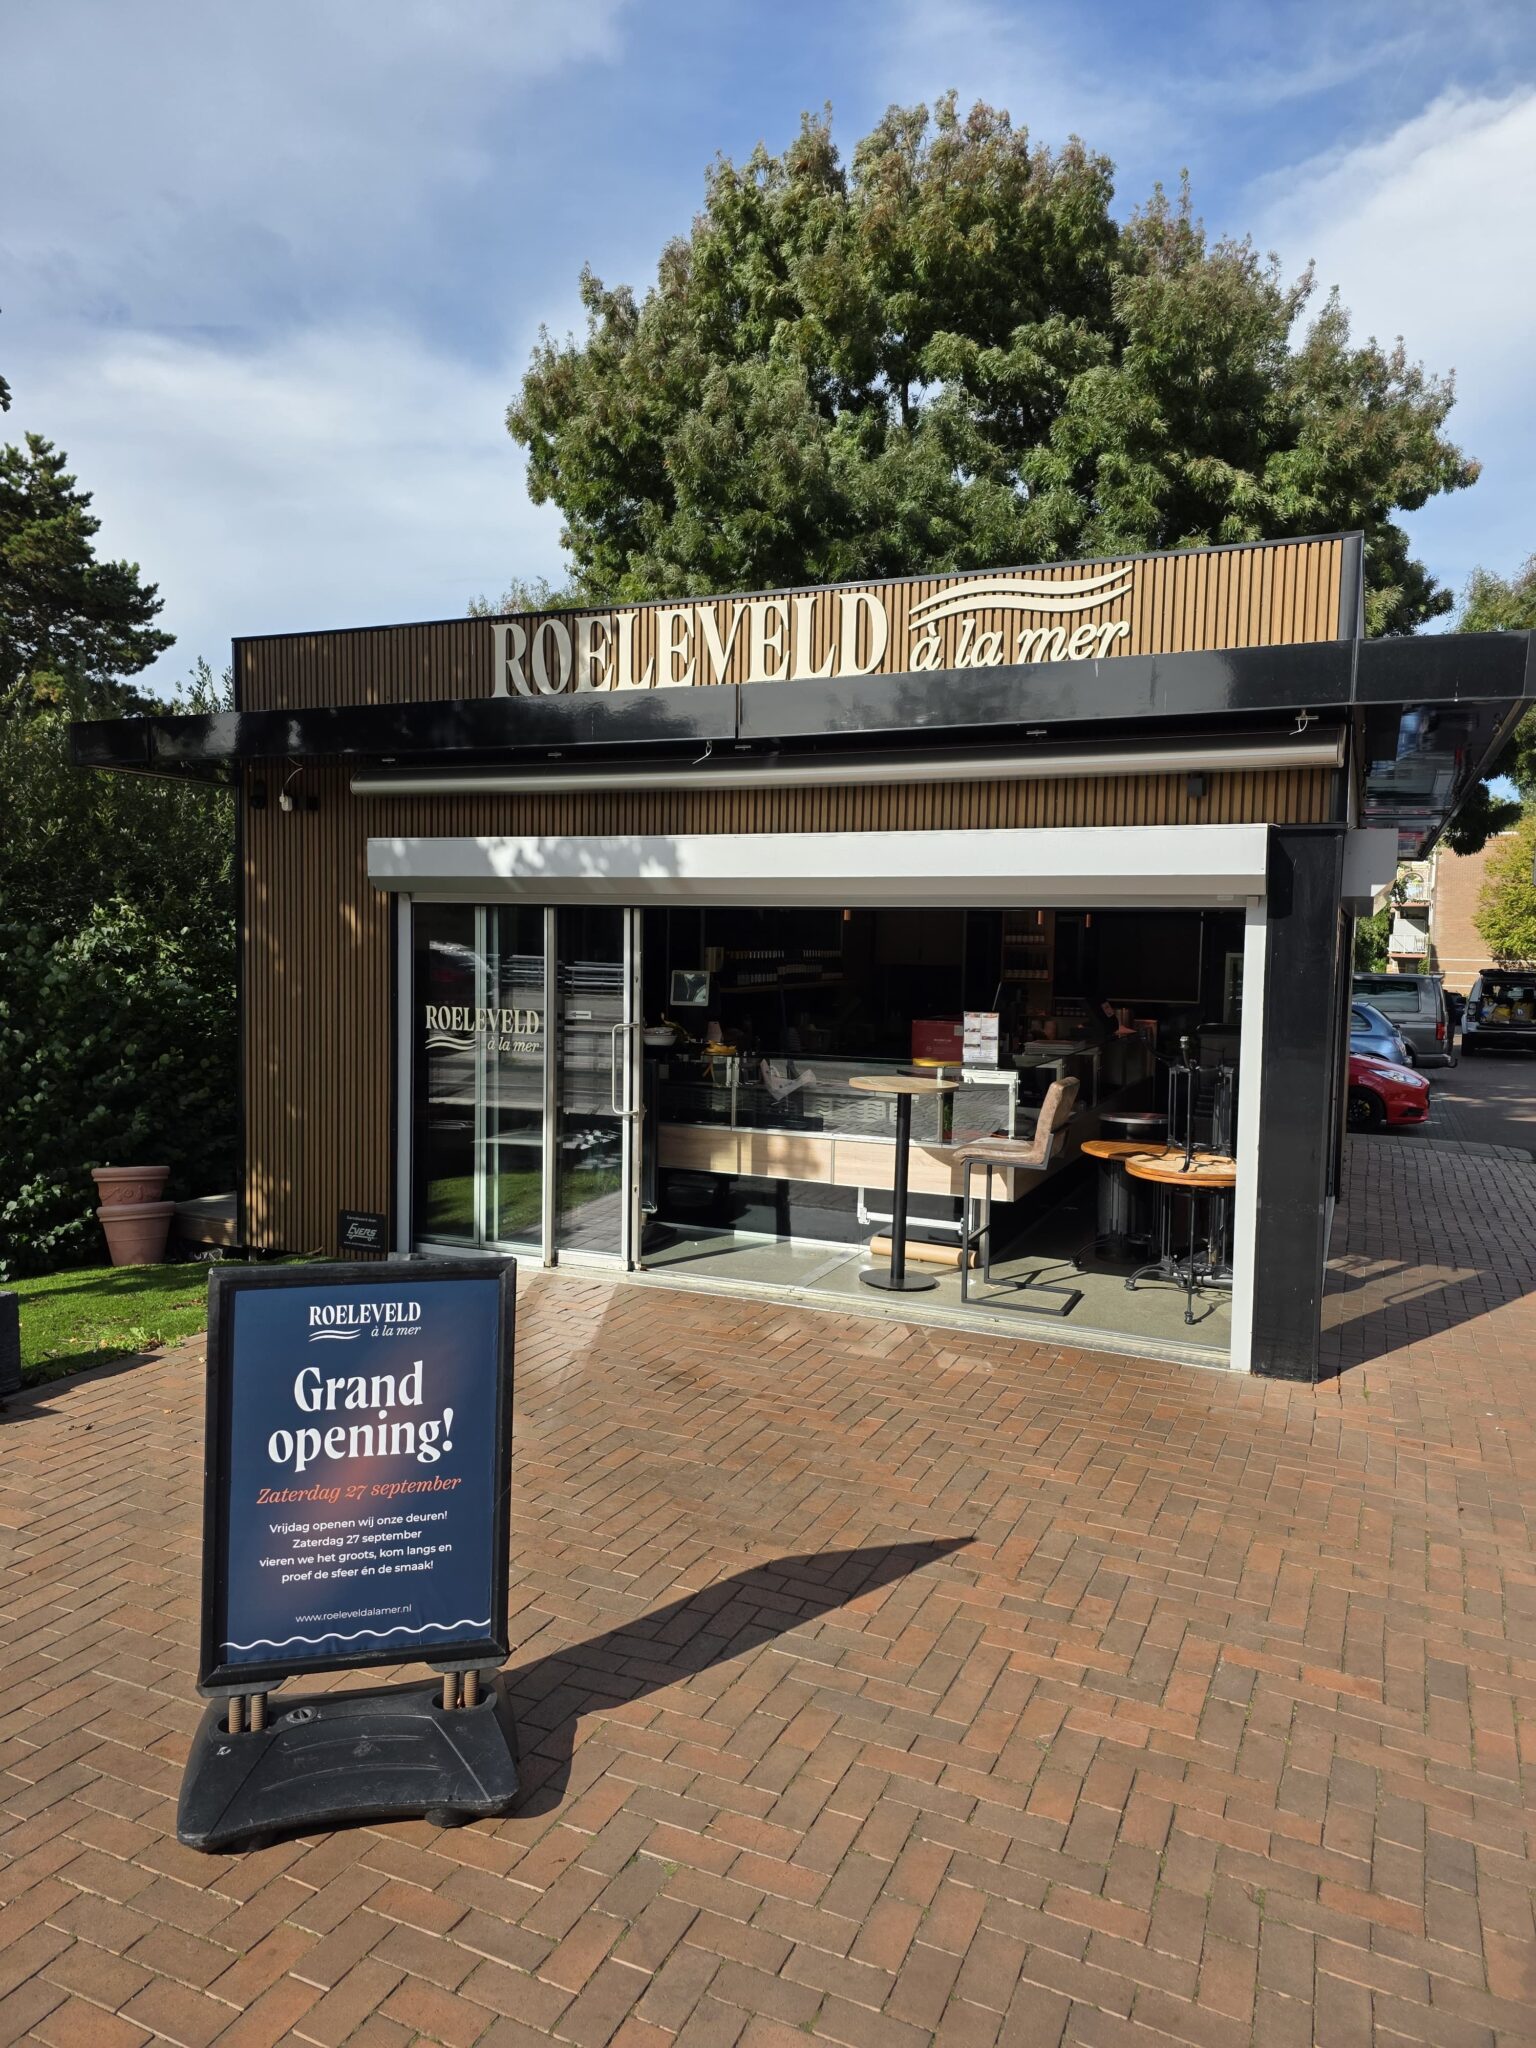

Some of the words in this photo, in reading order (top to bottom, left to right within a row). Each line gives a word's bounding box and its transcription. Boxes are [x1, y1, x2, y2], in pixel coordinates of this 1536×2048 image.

[490, 592, 888, 698] ROELEVELD
[909, 621, 942, 672] à
[954, 618, 1004, 669] la
[1016, 620, 1130, 665] mer
[425, 1005, 540, 1035] ROELEVELD
[487, 1035, 496, 1051] à
[498, 1036, 511, 1051] la
[513, 1042, 540, 1053] mer
[309, 1301, 422, 1326] ROELEVELD
[370, 1325, 380, 1337] à
[381, 1324, 394, 1337] la
[396, 1326, 422, 1336] mer
[294, 1360, 424, 1412] Grand
[268, 1407, 455, 1473] opening!
[256, 1484, 342, 1505] Zaterdag
[345, 1484, 369, 1500] 27
[370, 1475, 462, 1499] september
[269, 1522, 310, 1535] Vrijdag
[312, 1520, 356, 1532] openen
[358, 1516, 375, 1528] wij
[376, 1516, 404, 1526] onze
[405, 1510, 448, 1523] deuren!
[292, 1536, 344, 1549] Zaterdag
[346, 1534, 360, 1545] 27
[361, 1530, 422, 1544] september
[259, 1557, 295, 1567] vieren
[297, 1556, 315, 1565] we
[317, 1553, 336, 1563] het
[338, 1550, 377, 1563] groots,
[379, 1548, 404, 1558] kom
[406, 1545, 437, 1556] langs
[438, 1544, 452, 1552] en
[281, 1570, 312, 1584] proef
[313, 1570, 329, 1580] de
[330, 1568, 359, 1578] sfeer
[360, 1566, 376, 1576] én
[377, 1564, 393, 1575] de
[394, 1560, 434, 1573] smaak!
[295, 1603, 412, 1623] www.roeleveldalamer.nl
